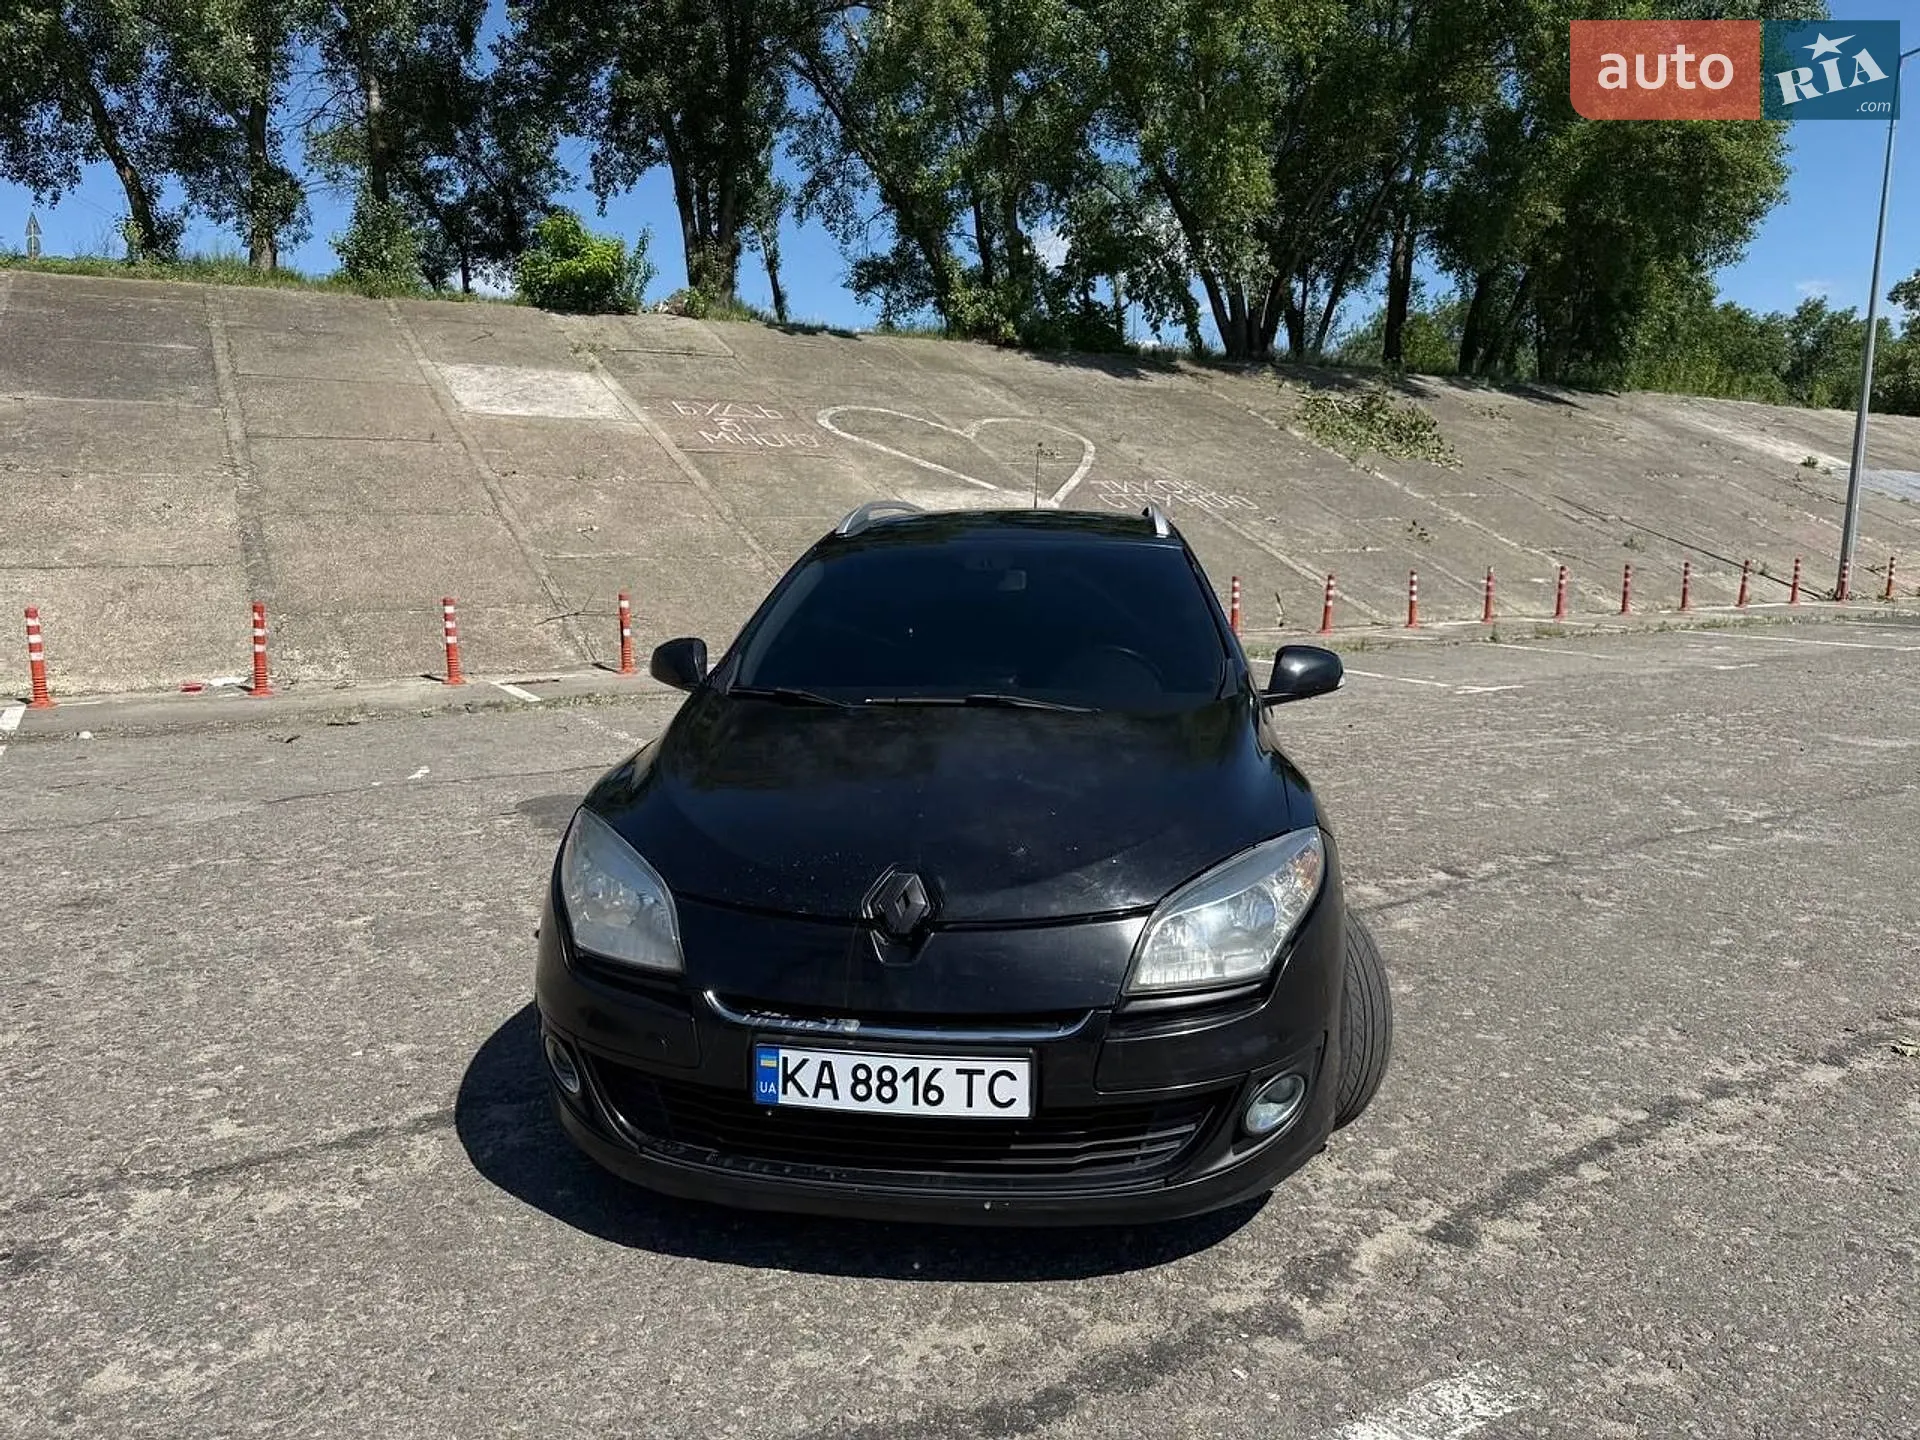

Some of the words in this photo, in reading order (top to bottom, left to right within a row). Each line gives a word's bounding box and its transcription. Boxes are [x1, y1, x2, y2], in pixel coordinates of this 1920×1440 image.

[760, 1081, 777, 1094] UA
[782, 1056, 840, 1100] KA
[850, 1063, 945, 1107] 8816
[956, 1068, 1017, 1109] TC
